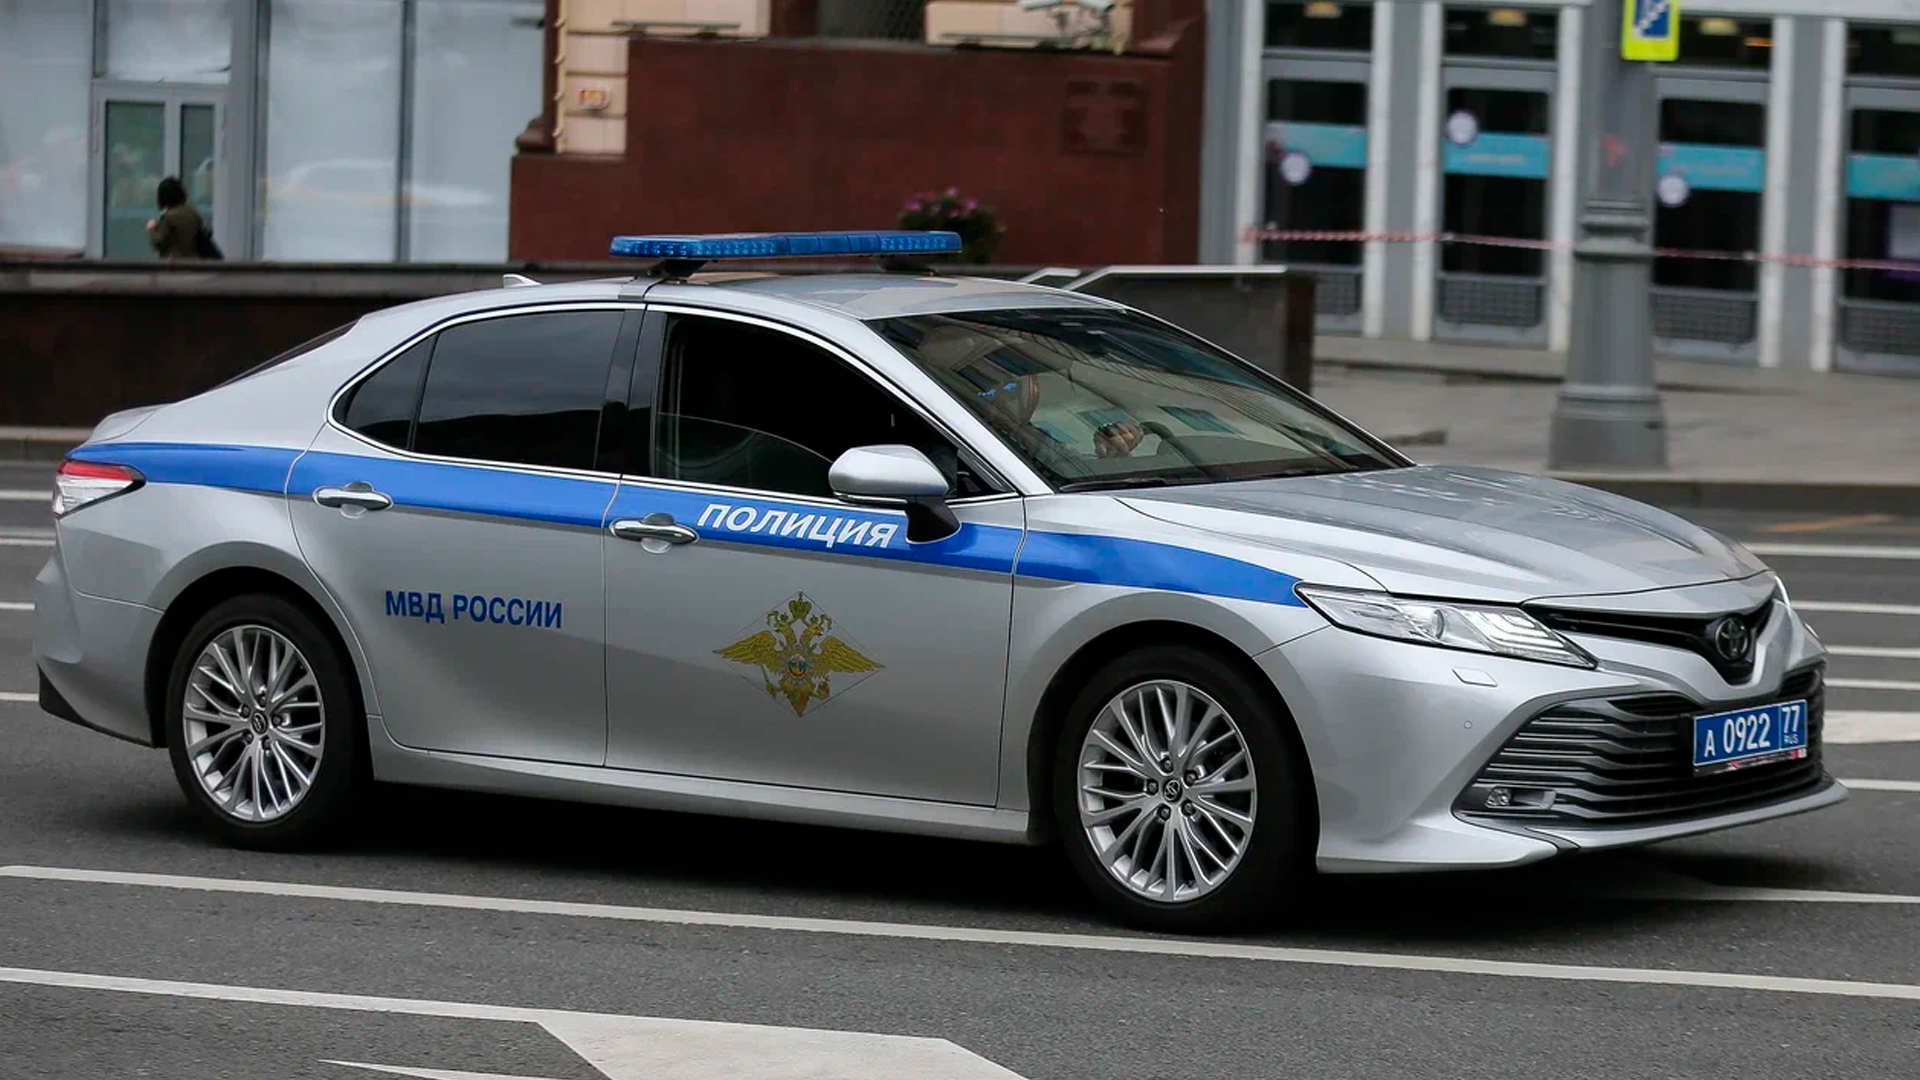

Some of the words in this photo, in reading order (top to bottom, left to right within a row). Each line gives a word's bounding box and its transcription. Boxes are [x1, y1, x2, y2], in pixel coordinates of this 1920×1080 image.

[697, 503, 899, 548] ПОЛИЦИЯ
[385, 590, 445, 624] МВД
[453, 594, 562, 629] РОССИИ
[1723, 713, 1771, 753] 0922
[1782, 706, 1800, 733] 77
[1784, 734, 1799, 744] RUS
